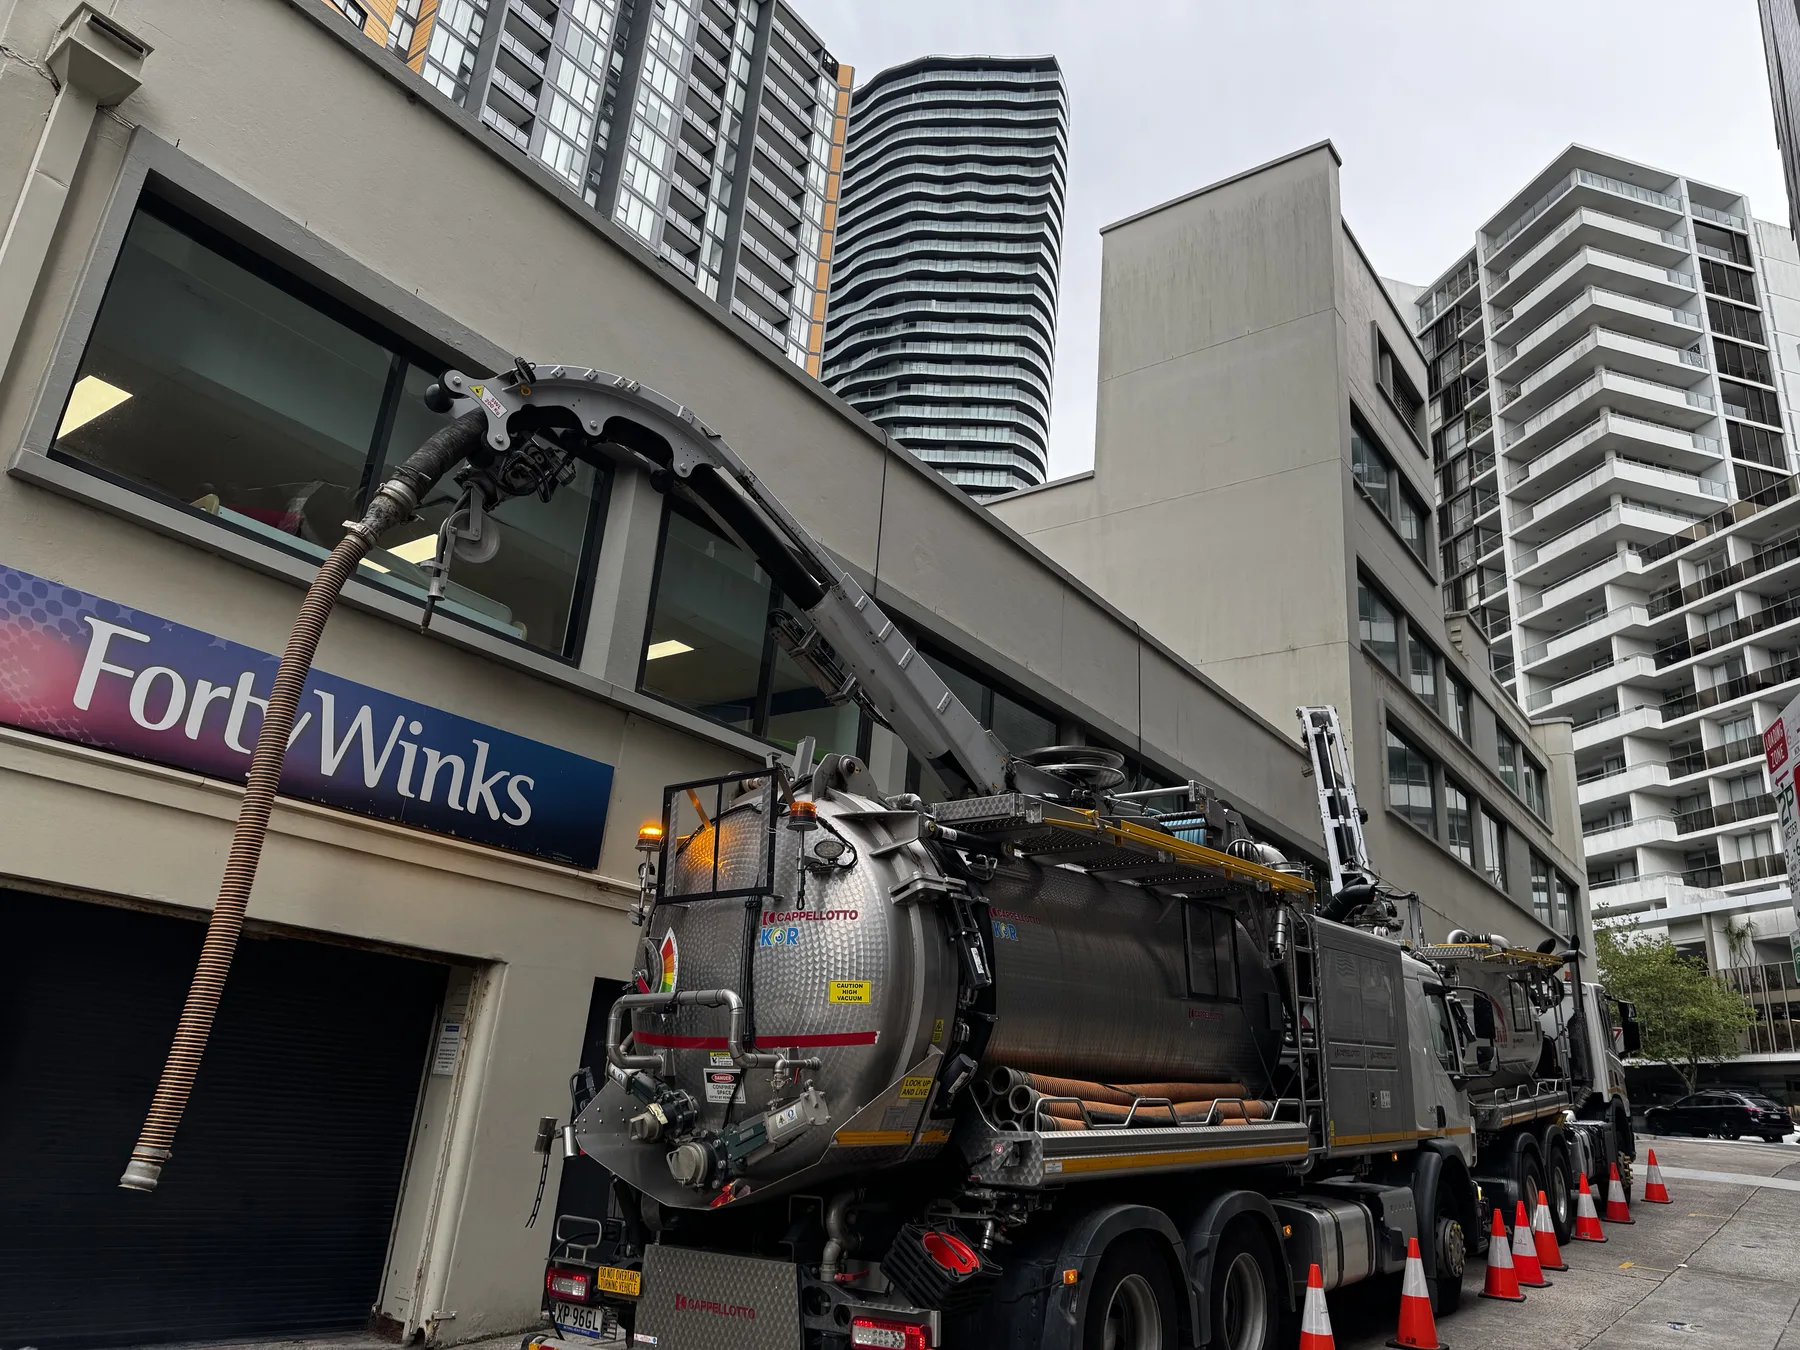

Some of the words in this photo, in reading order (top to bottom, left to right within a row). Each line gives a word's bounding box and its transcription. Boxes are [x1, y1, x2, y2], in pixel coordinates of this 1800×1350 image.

[1765, 722, 1784, 751] LOADING
[313, 689, 535, 826] Winks
[1770, 743, 1785, 769] ZONE
[1776, 784, 1794, 828] 2P
[776, 910, 859, 922] CAPPELLOTTO
[760, 927, 799, 946] KOR
[901, 1088, 915, 1096] AND
[915, 1088, 929, 1096] LIVE
[600, 1267, 607, 1279] DO
[607, 1268, 616, 1280] NOT
[616, 1269, 640, 1283] OVERTAKE
[600, 1278, 618, 1291] TURNING
[618, 1280, 637, 1295] VEHICLE
[687, 1298, 756, 1320] CAPPELLOTTO
